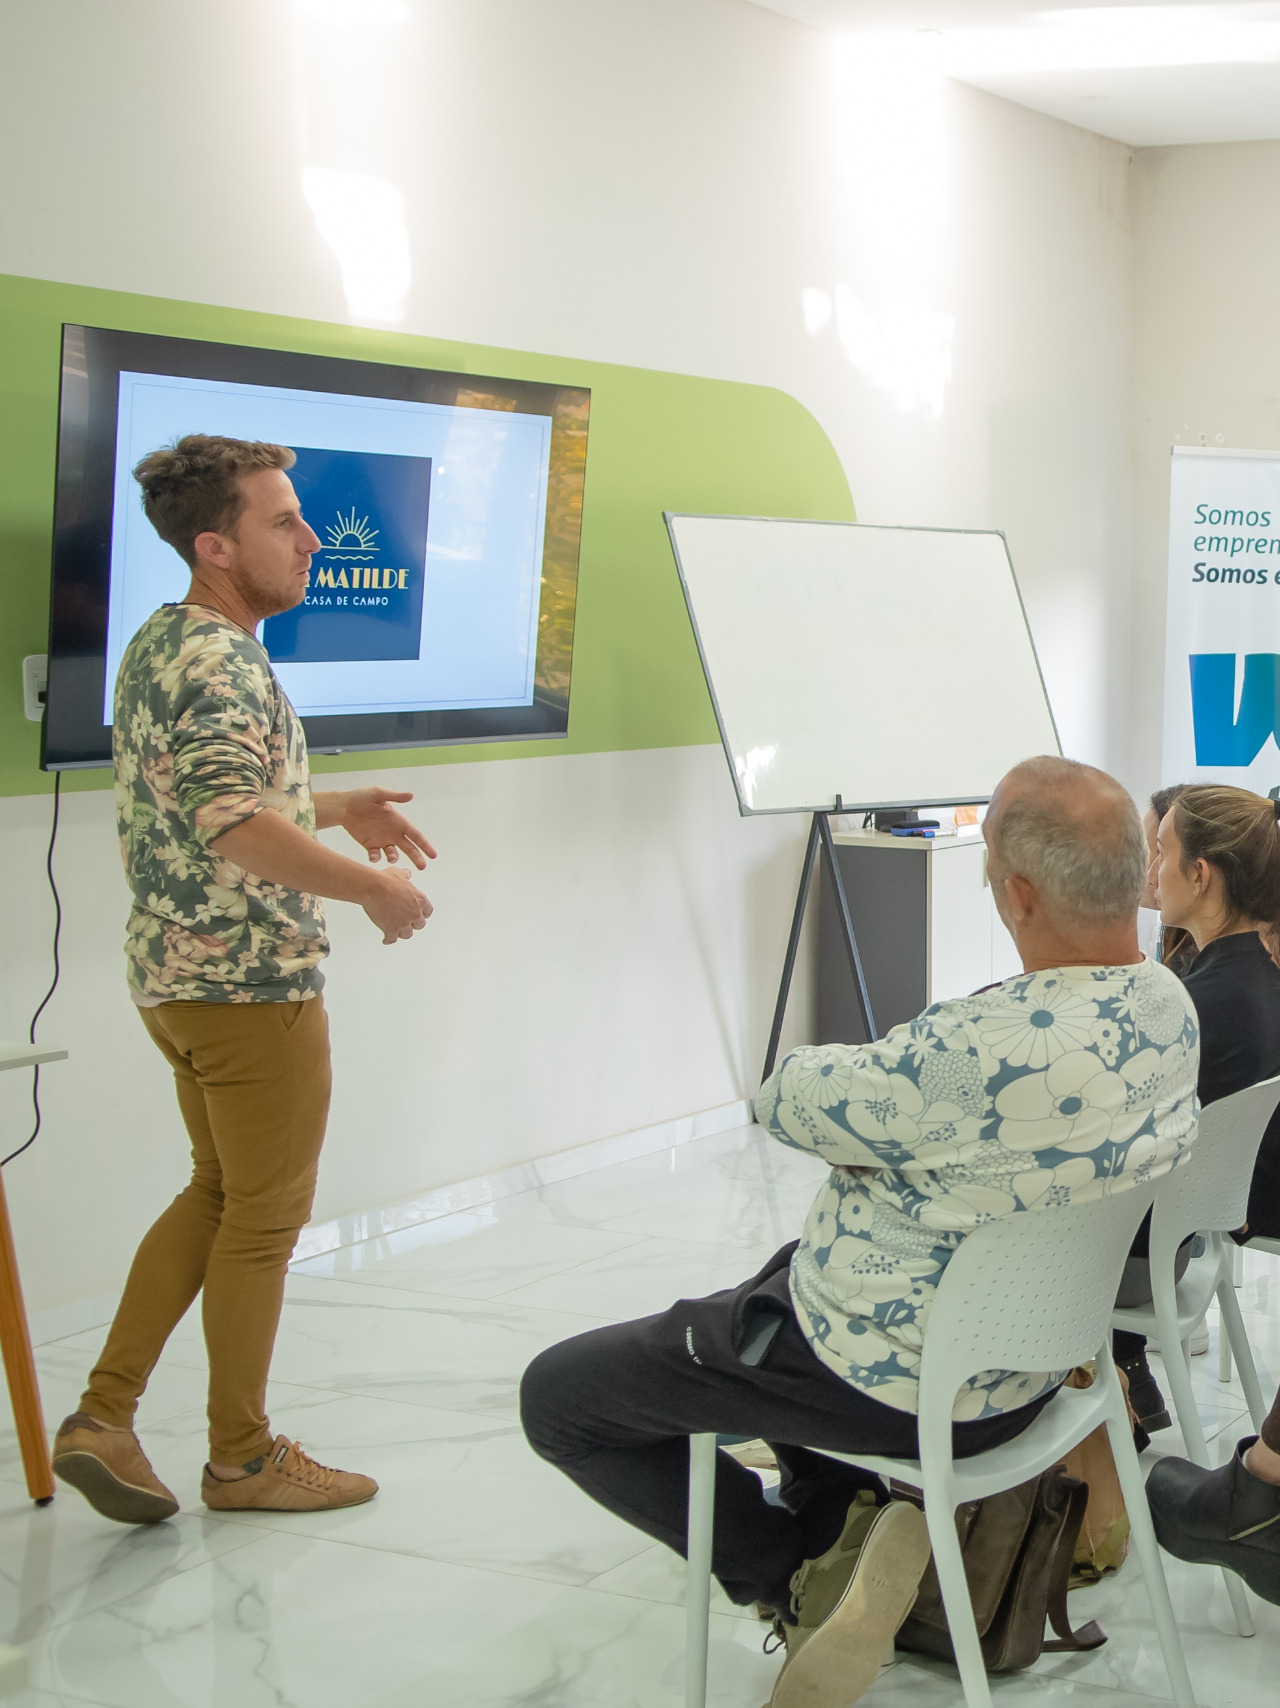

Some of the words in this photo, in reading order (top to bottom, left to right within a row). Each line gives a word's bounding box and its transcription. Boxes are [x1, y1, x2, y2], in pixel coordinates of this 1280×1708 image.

[1194, 503, 1271, 527] Somos
[314, 566, 410, 589] MATILDE
[1192, 562, 1268, 585] Somos
[304, 595, 332, 606] CASA
[336, 596, 349, 606] DE
[352, 596, 389, 607] CAMPO
